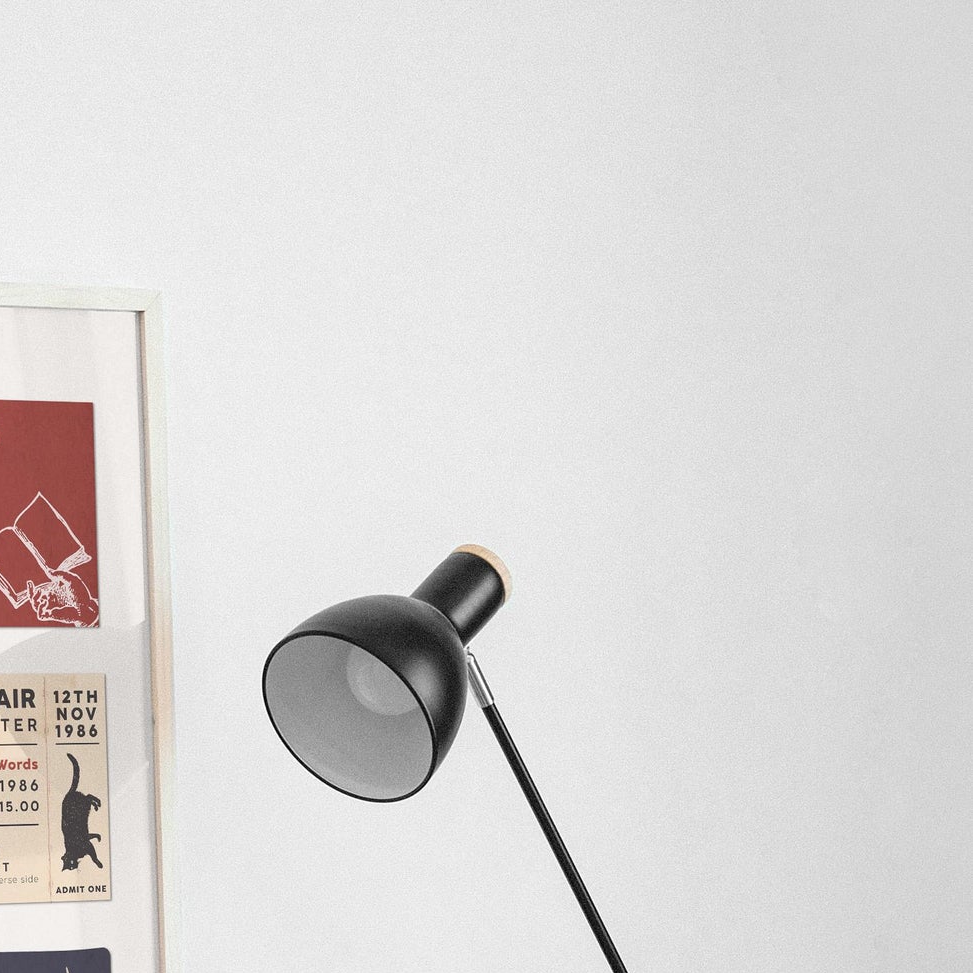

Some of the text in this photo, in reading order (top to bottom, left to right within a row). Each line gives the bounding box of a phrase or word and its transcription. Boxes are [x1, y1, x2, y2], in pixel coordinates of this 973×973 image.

[53, 691, 98, 703] 12TH
[57, 708, 96, 720] NOV
[55, 724, 98, 737] 1986
[0, 780, 38, 792] 1986
[0, 801, 39, 812] 15.00
[88, 885, 106, 893] ONE
